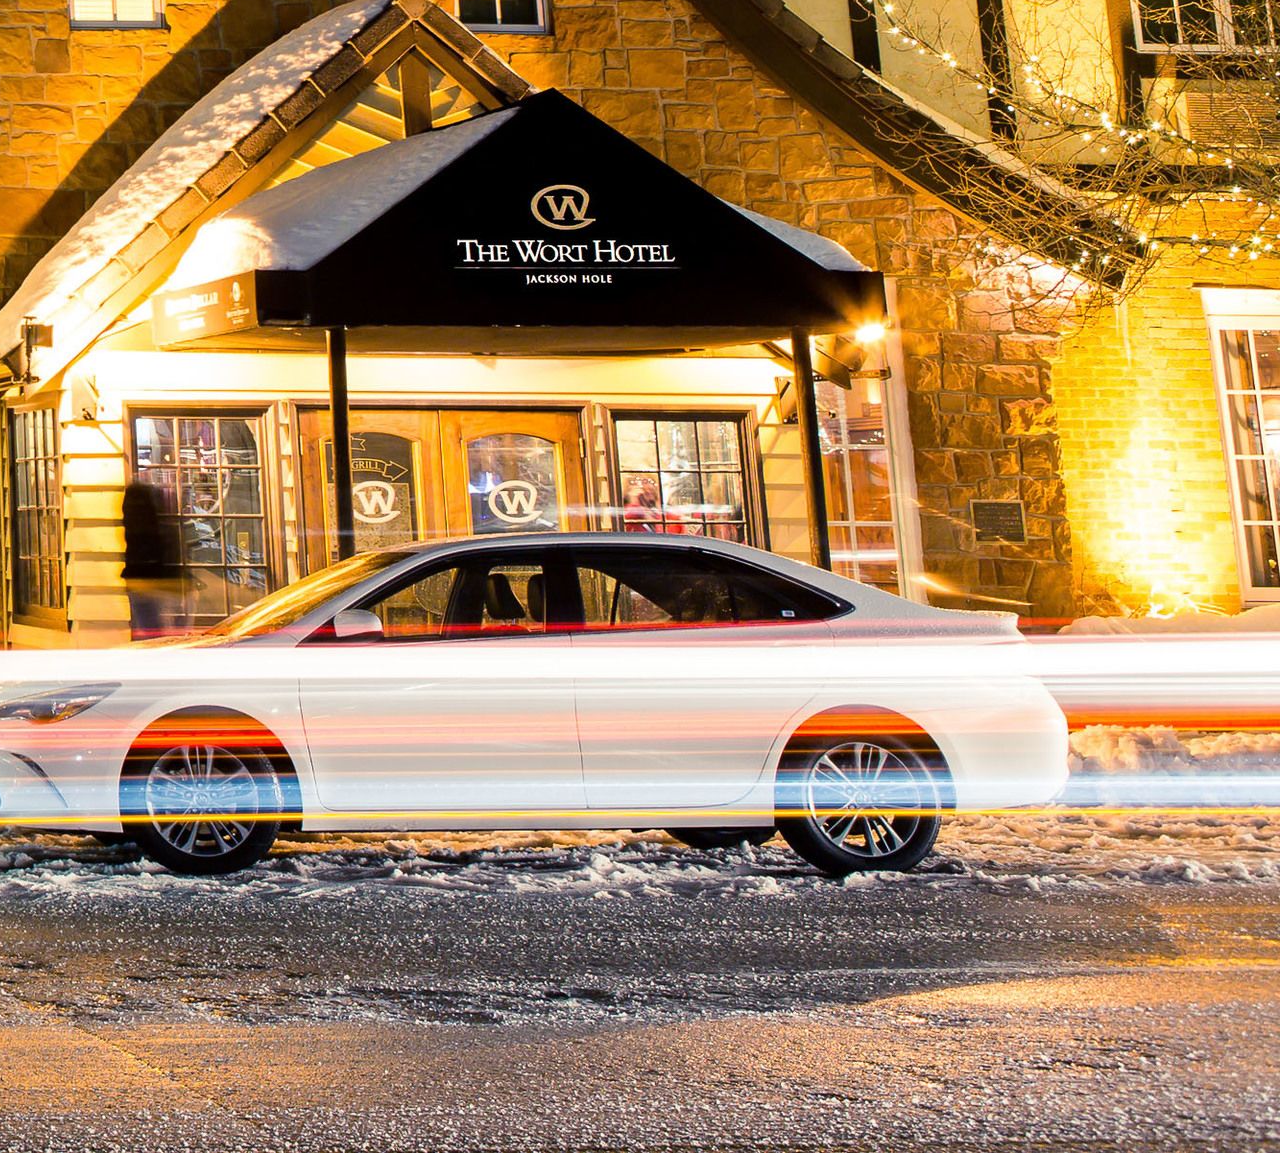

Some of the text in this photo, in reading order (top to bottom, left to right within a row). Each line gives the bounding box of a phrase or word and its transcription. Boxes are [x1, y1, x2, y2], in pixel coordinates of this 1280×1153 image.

[456, 239, 676, 263] THE WORT HOTEL
[526, 274, 613, 285] JACKSON HOLE
[352, 460, 381, 469] GRILL
